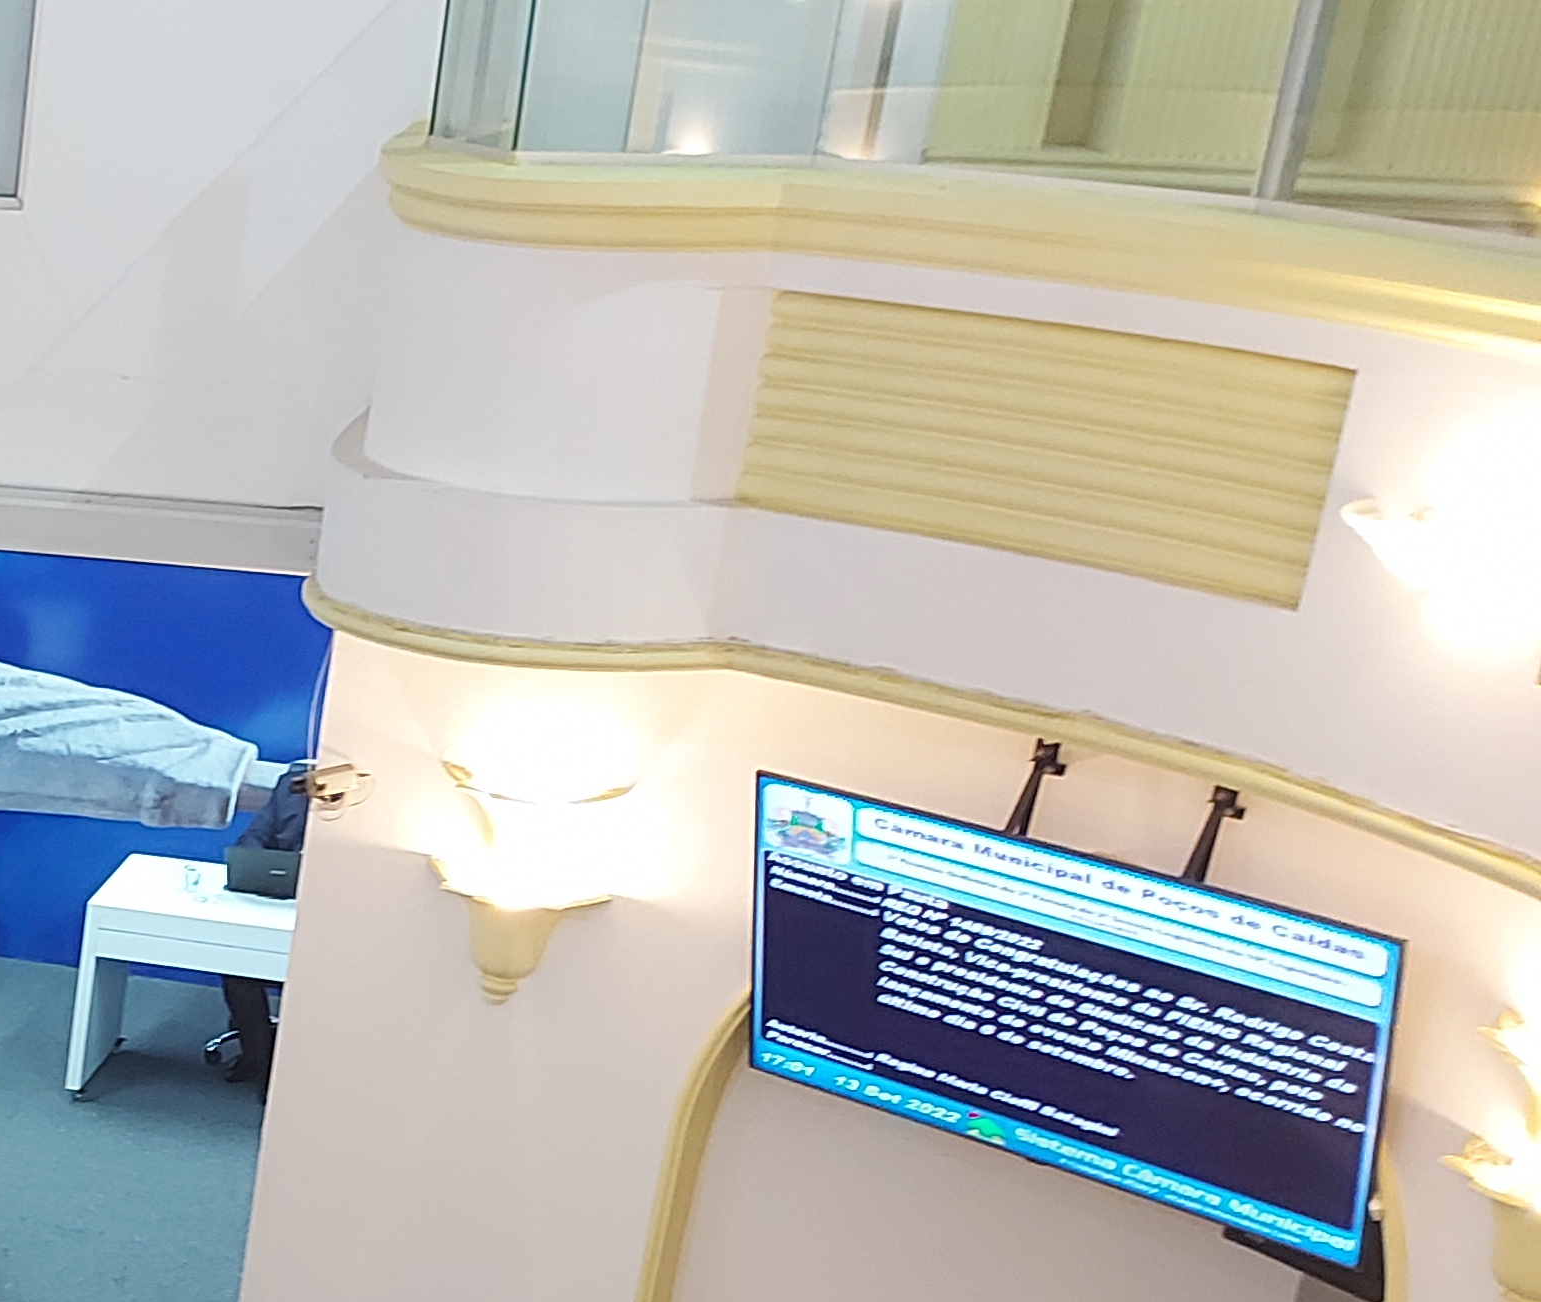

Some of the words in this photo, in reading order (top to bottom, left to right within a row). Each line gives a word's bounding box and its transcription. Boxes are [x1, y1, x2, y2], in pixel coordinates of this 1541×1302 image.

[874, 818, 963, 849] Câmara
[974, 843, 1091, 883] Municipal
[1101, 879, 1130, 893] de
[1141, 888, 1218, 918] Poços
[1230, 914, 1261, 929] de
[1272, 924, 1364, 959] Caldas
[943, 930, 971, 943] de
[1214, 1007, 1304, 1040] Rodrigo
[762, 1052, 814, 1075] 17:01
[834, 1076, 859, 1090] 13
[906, 1099, 960, 1122] 2022
[1015, 1128, 1116, 1169] Sistema
[1122, 1164, 1220, 1205] Câmara
[1229, 1199, 1353, 1250] Municipal
